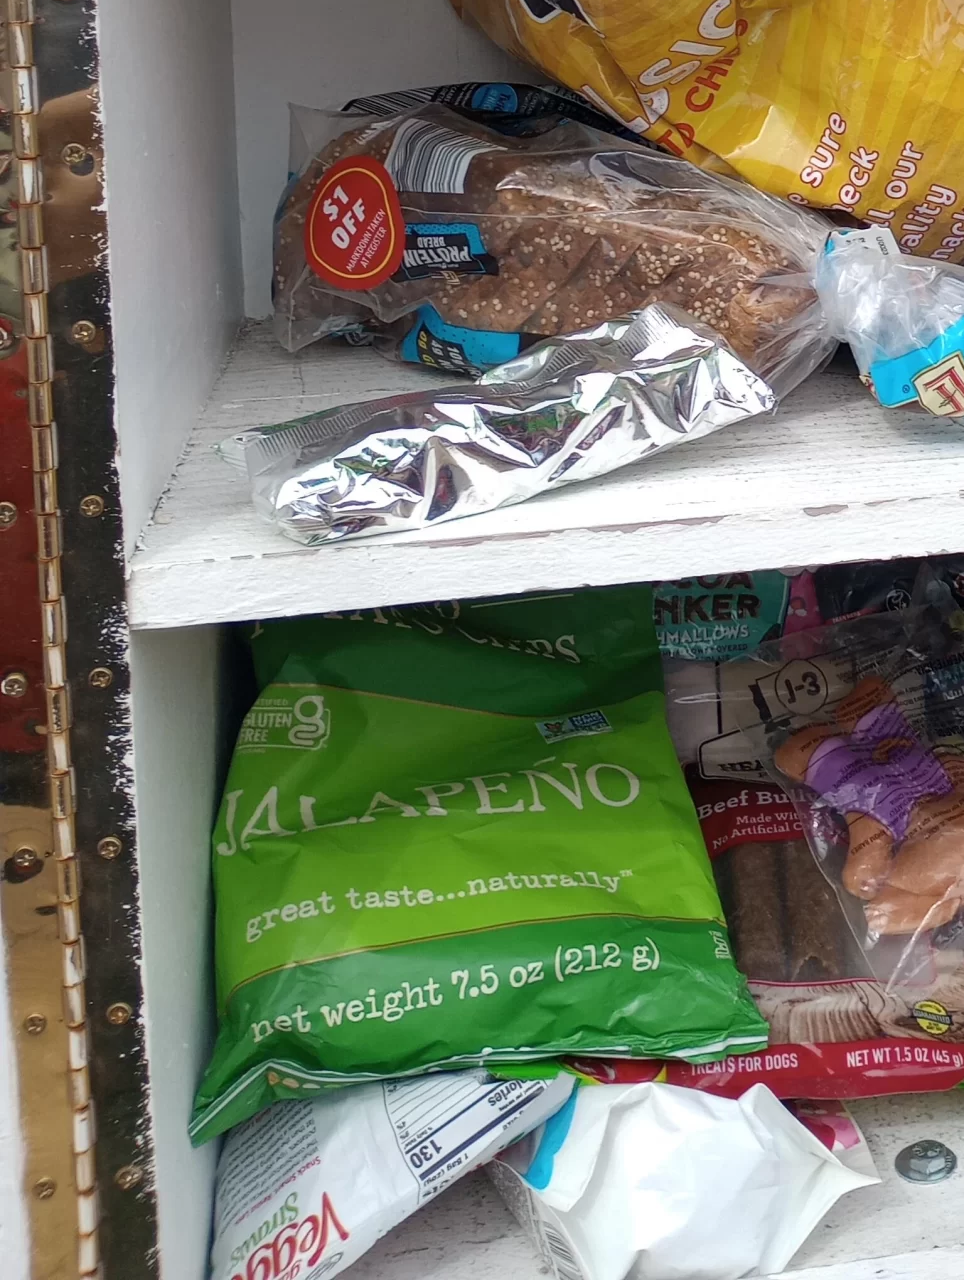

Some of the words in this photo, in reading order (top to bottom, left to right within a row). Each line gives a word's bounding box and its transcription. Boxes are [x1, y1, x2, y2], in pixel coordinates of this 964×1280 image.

[800, 111, 847, 188] sure
[886, 141, 926, 200] our
[323, 185, 349, 222] $1
[331, 197, 366, 249] OFF
[346, 230, 372, 272] MARKDOWN
[367, 208, 386, 234] TAKEN
[360, 257, 370, 269] AT
[365, 226, 387, 260] REGISTER
[416, 236, 446, 248] BREAD
[403, 245, 473, 269] PROTEIN
[239, 728, 268, 743] FREE
[243, 713, 292, 729] GLUTEN
[216, 756, 641, 858] JALAPEÑO
[698, 790, 749, 820] Beef
[736, 815, 771, 826] Made
[712, 835, 729, 850] No
[732, 821, 790, 839] Artificial
[245, 891, 335, 943] great
[251, 1005, 312, 1044] net
[320, 976, 444, 1027] weight
[451, 964, 500, 1001] 7.5
[508, 957, 545, 988] oz
[554, 942, 621, 985] (212
[632, 936, 661, 973] g)
[738, 1056, 762, 1072] FOR
[763, 1052, 798, 1072] DOGS
[846, 1050, 870, 1068] NET
[872, 1050, 890, 1066] WT
[893, 1049, 911, 1065] 1.5
[913, 1047, 930, 1063] OZ
[931, 1046, 951, 1066] (45
[952, 1050, 964, 1069] g)
[409, 1138, 443, 1170] 130
